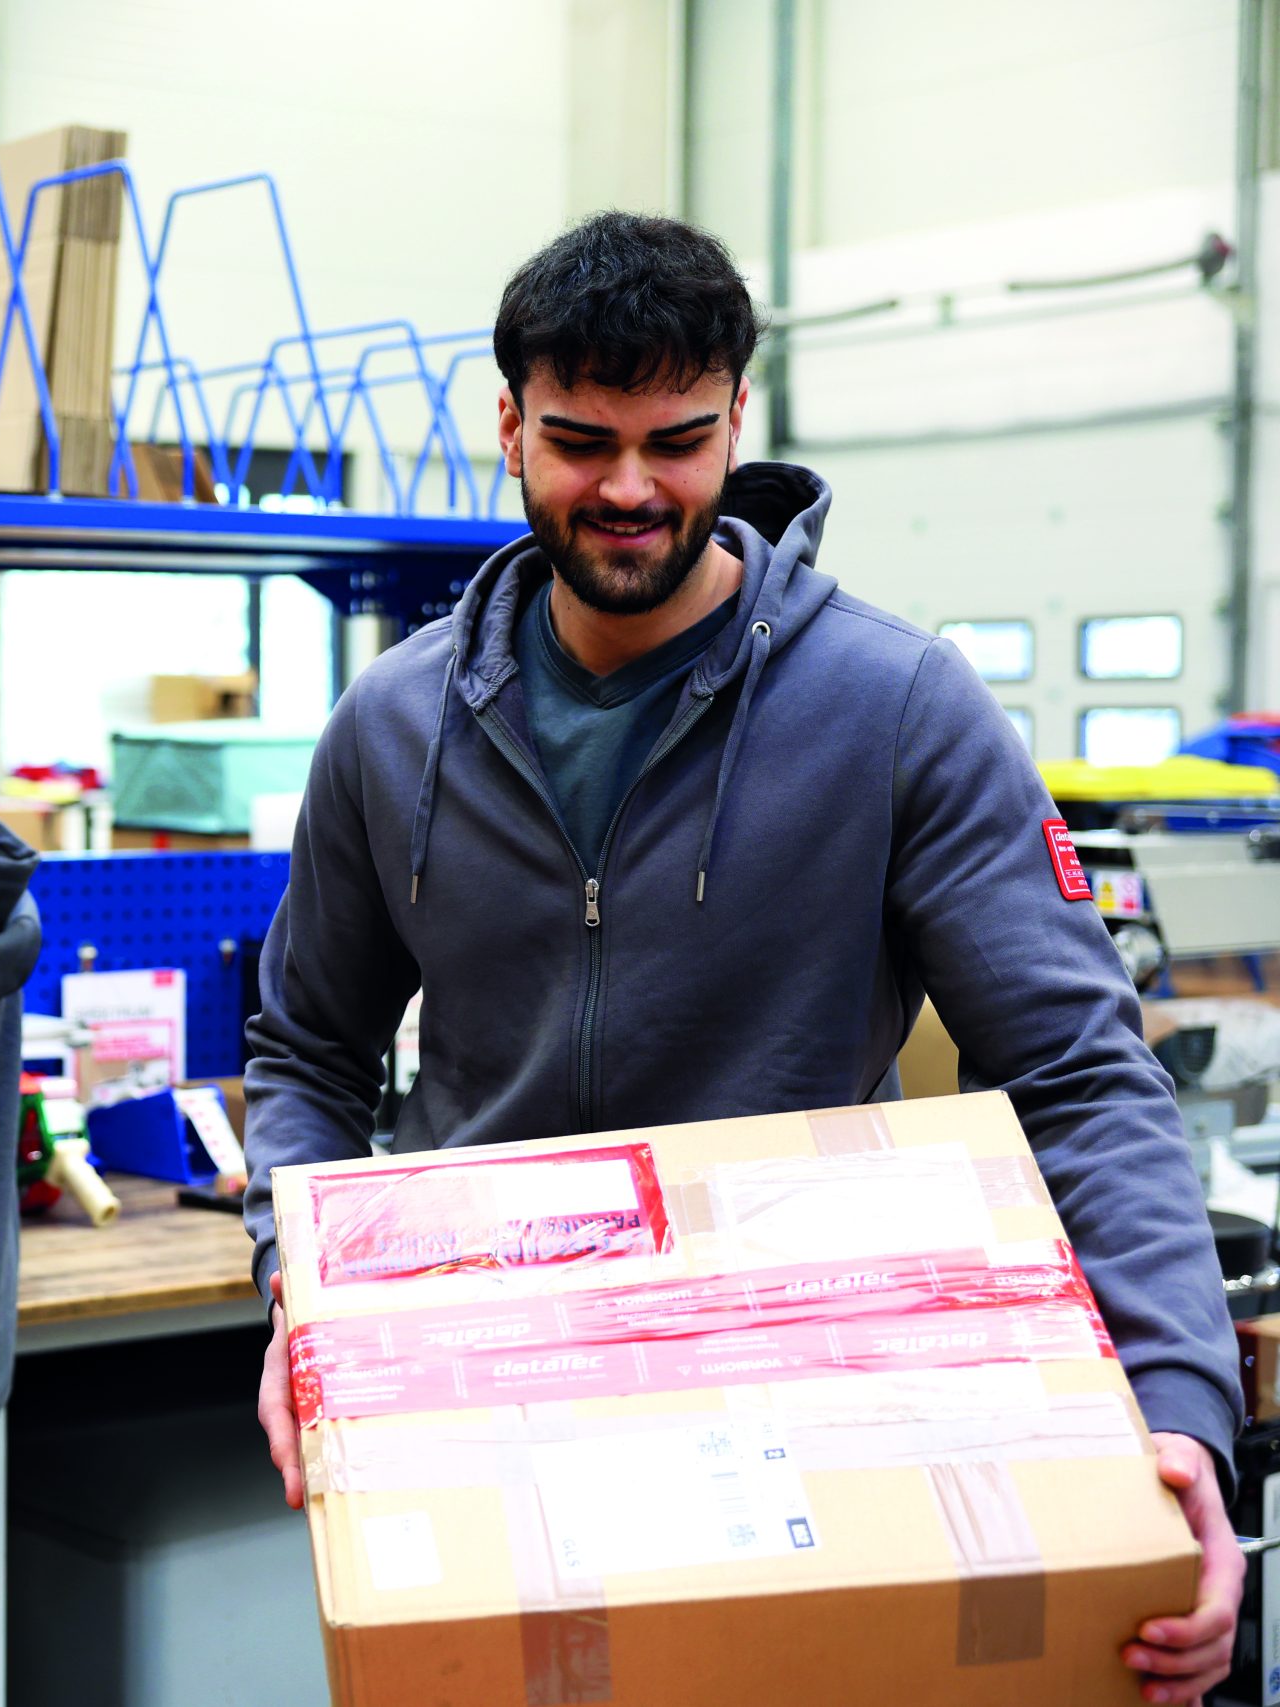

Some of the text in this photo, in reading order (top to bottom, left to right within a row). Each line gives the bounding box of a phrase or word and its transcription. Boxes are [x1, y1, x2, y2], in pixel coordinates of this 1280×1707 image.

[785, 1271, 897, 1295] dataTec
[613, 1289, 692, 1306] VORSICHT!
[420, 1322, 532, 1347] dataTec
[872, 1331, 988, 1352] dataTec
[492, 1354, 606, 1378] dataTec
[701, 1357, 784, 1374] VORSICHT!
